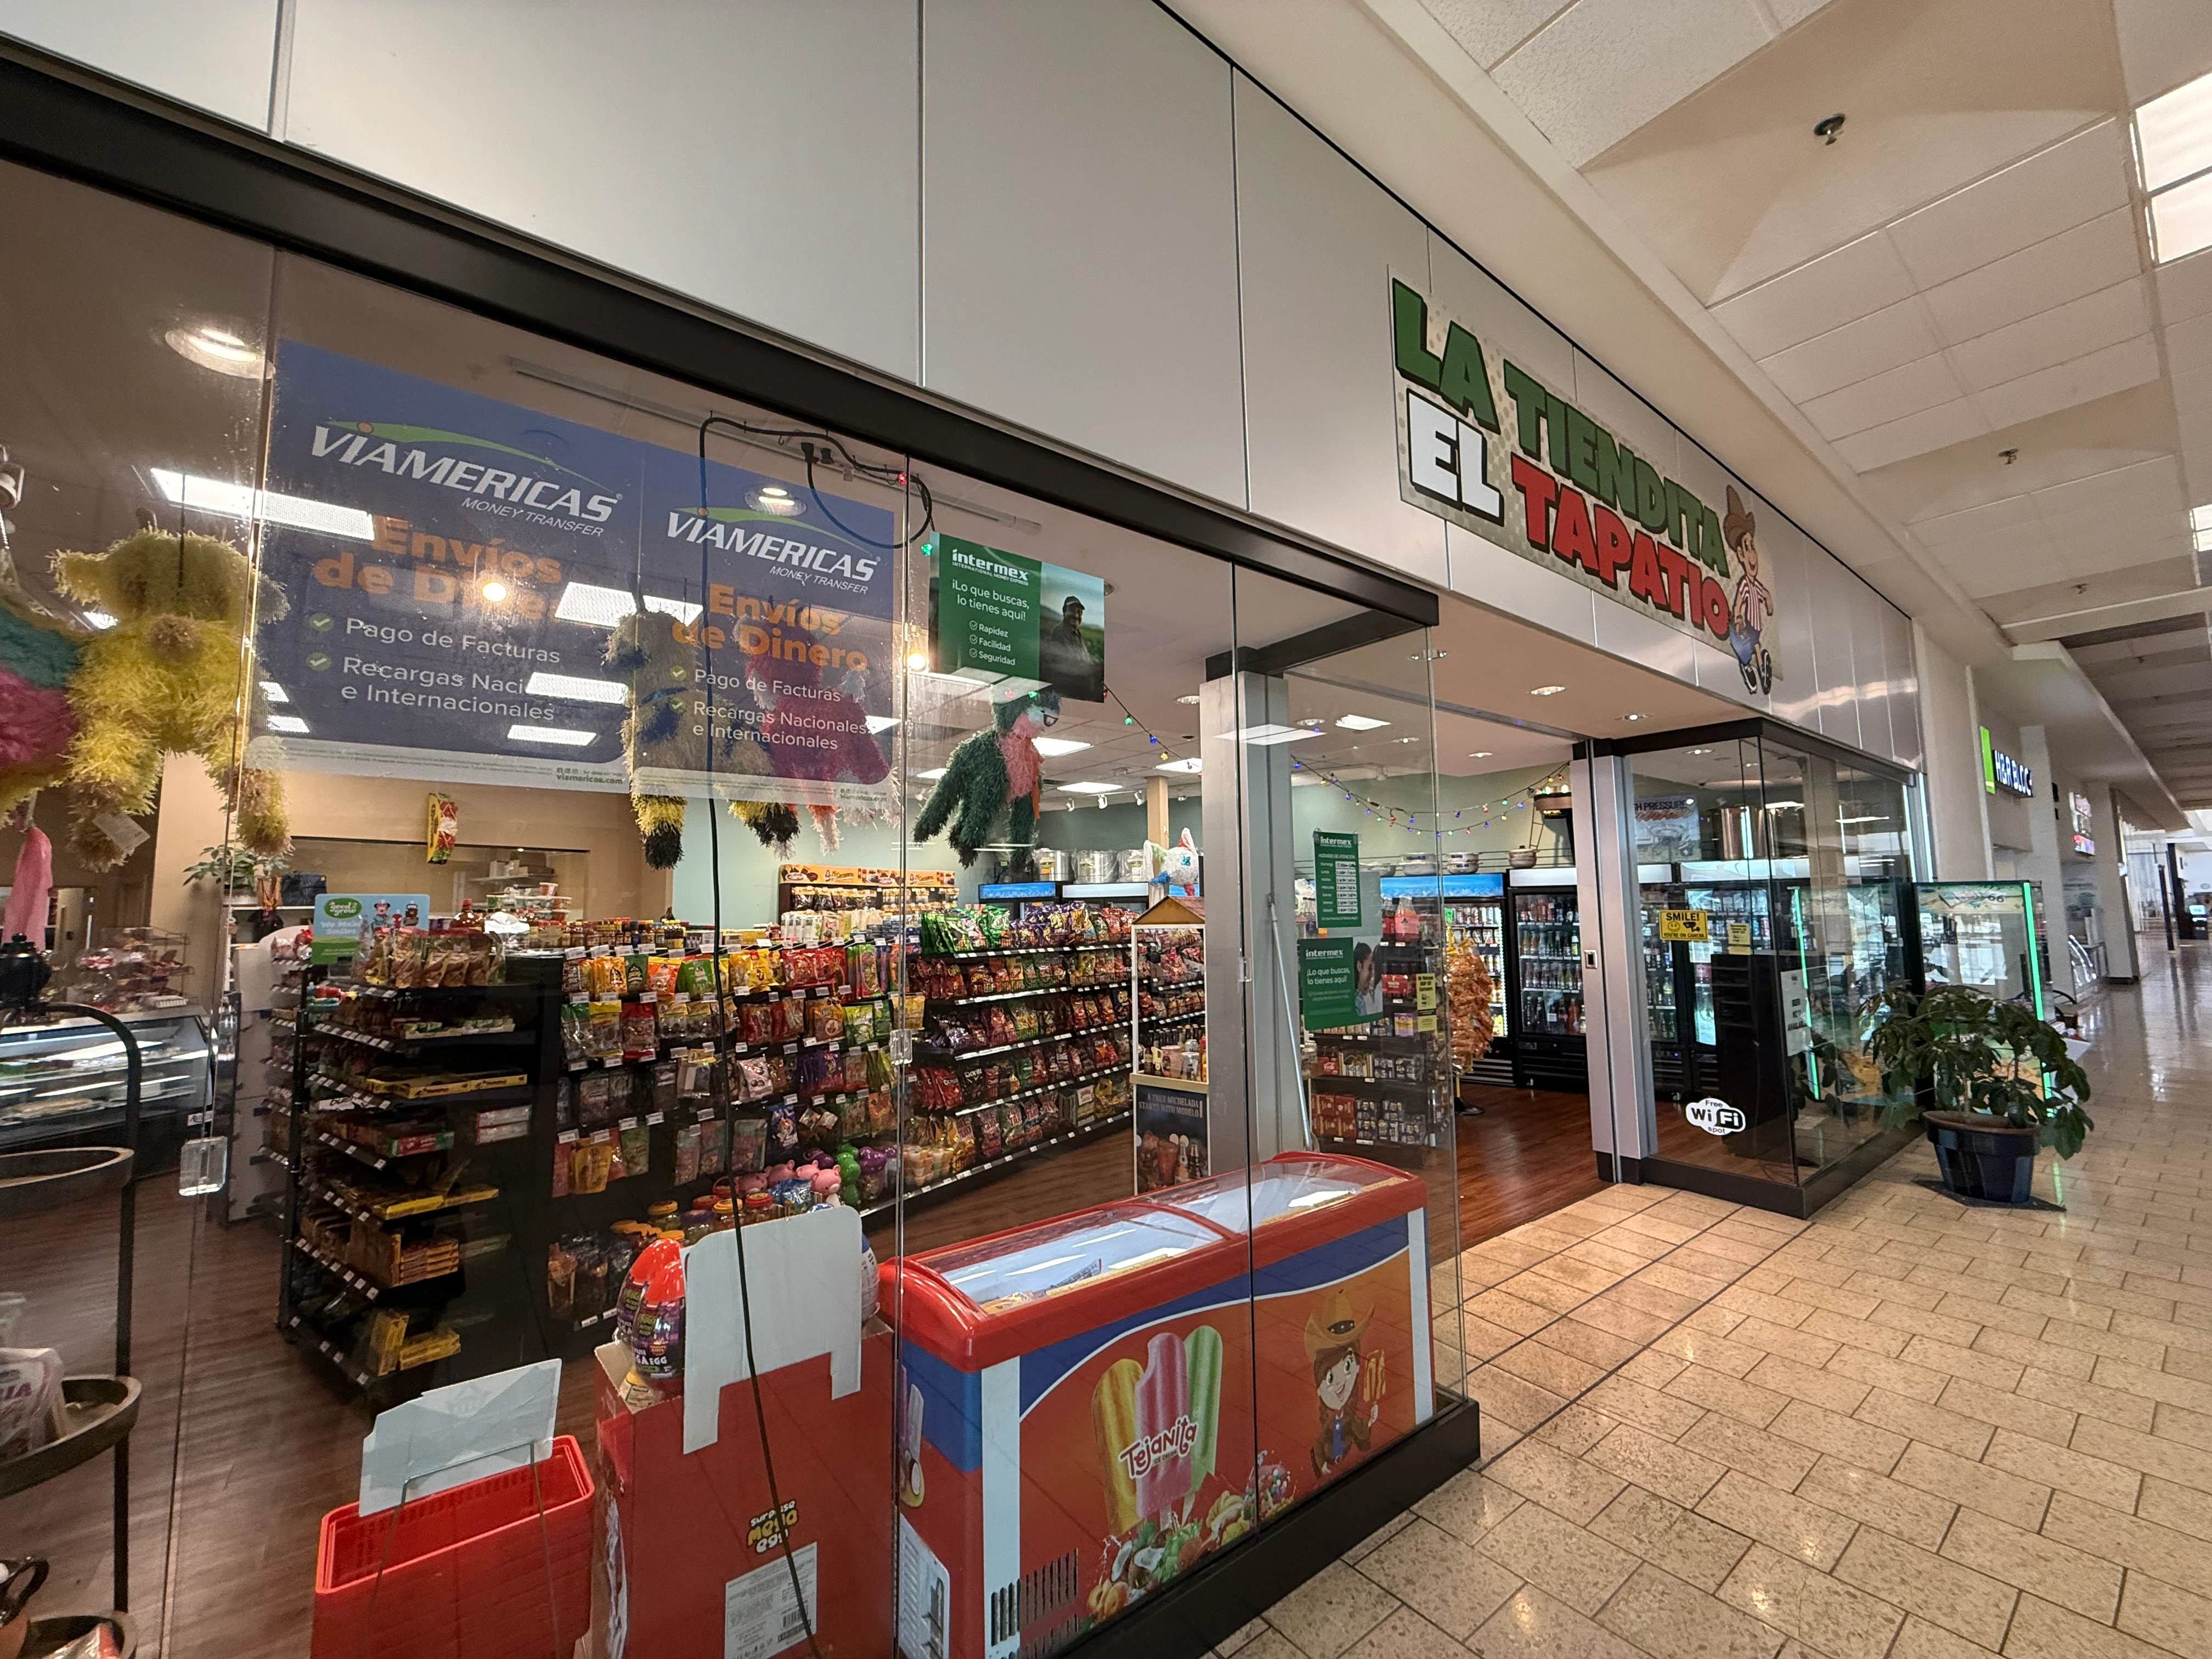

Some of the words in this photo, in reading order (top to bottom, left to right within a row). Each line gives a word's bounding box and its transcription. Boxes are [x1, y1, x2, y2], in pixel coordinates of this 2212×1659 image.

[1392, 278, 1501, 435] LA
[1503, 359, 1730, 578] TIENDITA
[461, 497, 524, 518] MONEY
[524, 511, 605, 538] TRANSFER
[1407, 388, 1504, 527] EL
[1511, 452, 1733, 640] TAPATIO
[373, 515, 562, 583] Envíos
[312, 552, 394, 595] de
[952, 549, 1028, 581] intermex
[952, 561, 992, 578] INTERNATIONAL
[994, 573, 1009, 582] MONEY
[1009, 577, 1029, 586] EXPRESS
[769, 566, 812, 581] MONEY
[812, 575, 868, 595] TRANSFER
[952, 579, 968, 593] ¡Lo
[970, 587, 990, 600] que
[992, 590, 1030, 610] buscas,
[709, 583, 842, 635] Envíos
[957, 595, 967, 606] lo
[969, 599, 1000, 614] tienes
[1002, 609, 1026, 621] aquí!
[346, 618, 414, 644] Pago
[422, 630, 454, 648] de
[462, 635, 561, 664] Facturas
[672, 619, 725, 650] de
[740, 623, 867, 672] Dinero
[979, 623, 1008, 638] Rapidez
[979, 637, 1011, 652] Facilidad
[343, 657, 466, 687] Recargas
[979, 651, 1015, 665] Seguridad
[694, 669, 740, 690] Pago
[746, 676, 767, 692] de
[773, 681, 842, 702] Facturas
[341, 686, 358, 700] e
[368, 685, 554, 720] Internacionales
[694, 702, 775, 725] Recargas
[781, 712, 867, 734] Nacionales
[692, 726, 704, 737] e
[710, 724, 838, 751] Internacionales
[556, 774, 623, 784] viamericas.com
[1320, 836, 1351, 845] intermex
[1666, 912, 1700, 921] SMILE!
[1138, 1102, 1160, 1110] STARTS
[1161, 1104, 1175, 1113] WITH
[1176, 1105, 1199, 1117] MODELO
[1167, 1096, 1199, 1108] MICHELADA
[650, 1356, 668, 1365] EGG
[1120, 1418, 1197, 1476] Tejanita
